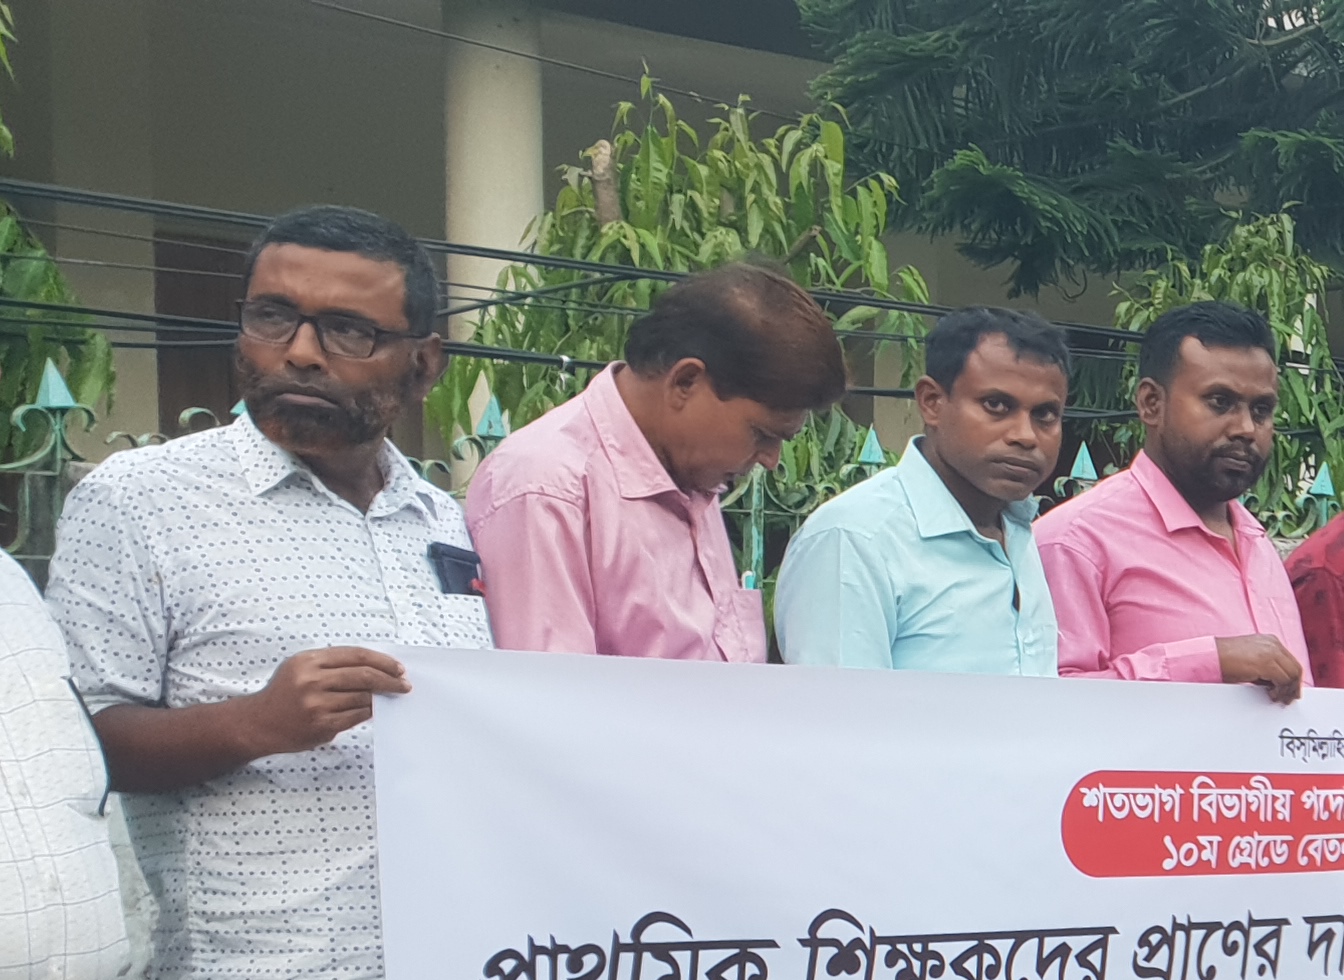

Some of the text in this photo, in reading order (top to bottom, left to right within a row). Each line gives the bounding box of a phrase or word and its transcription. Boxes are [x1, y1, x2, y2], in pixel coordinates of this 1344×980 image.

[1079, 783, 1184, 823] শতভাগ
[1190, 775, 1295, 824] বিভাগীয়
[1162, 835, 1223, 871] ১০ম
[1228, 831, 1293, 870] গ্রেডে
